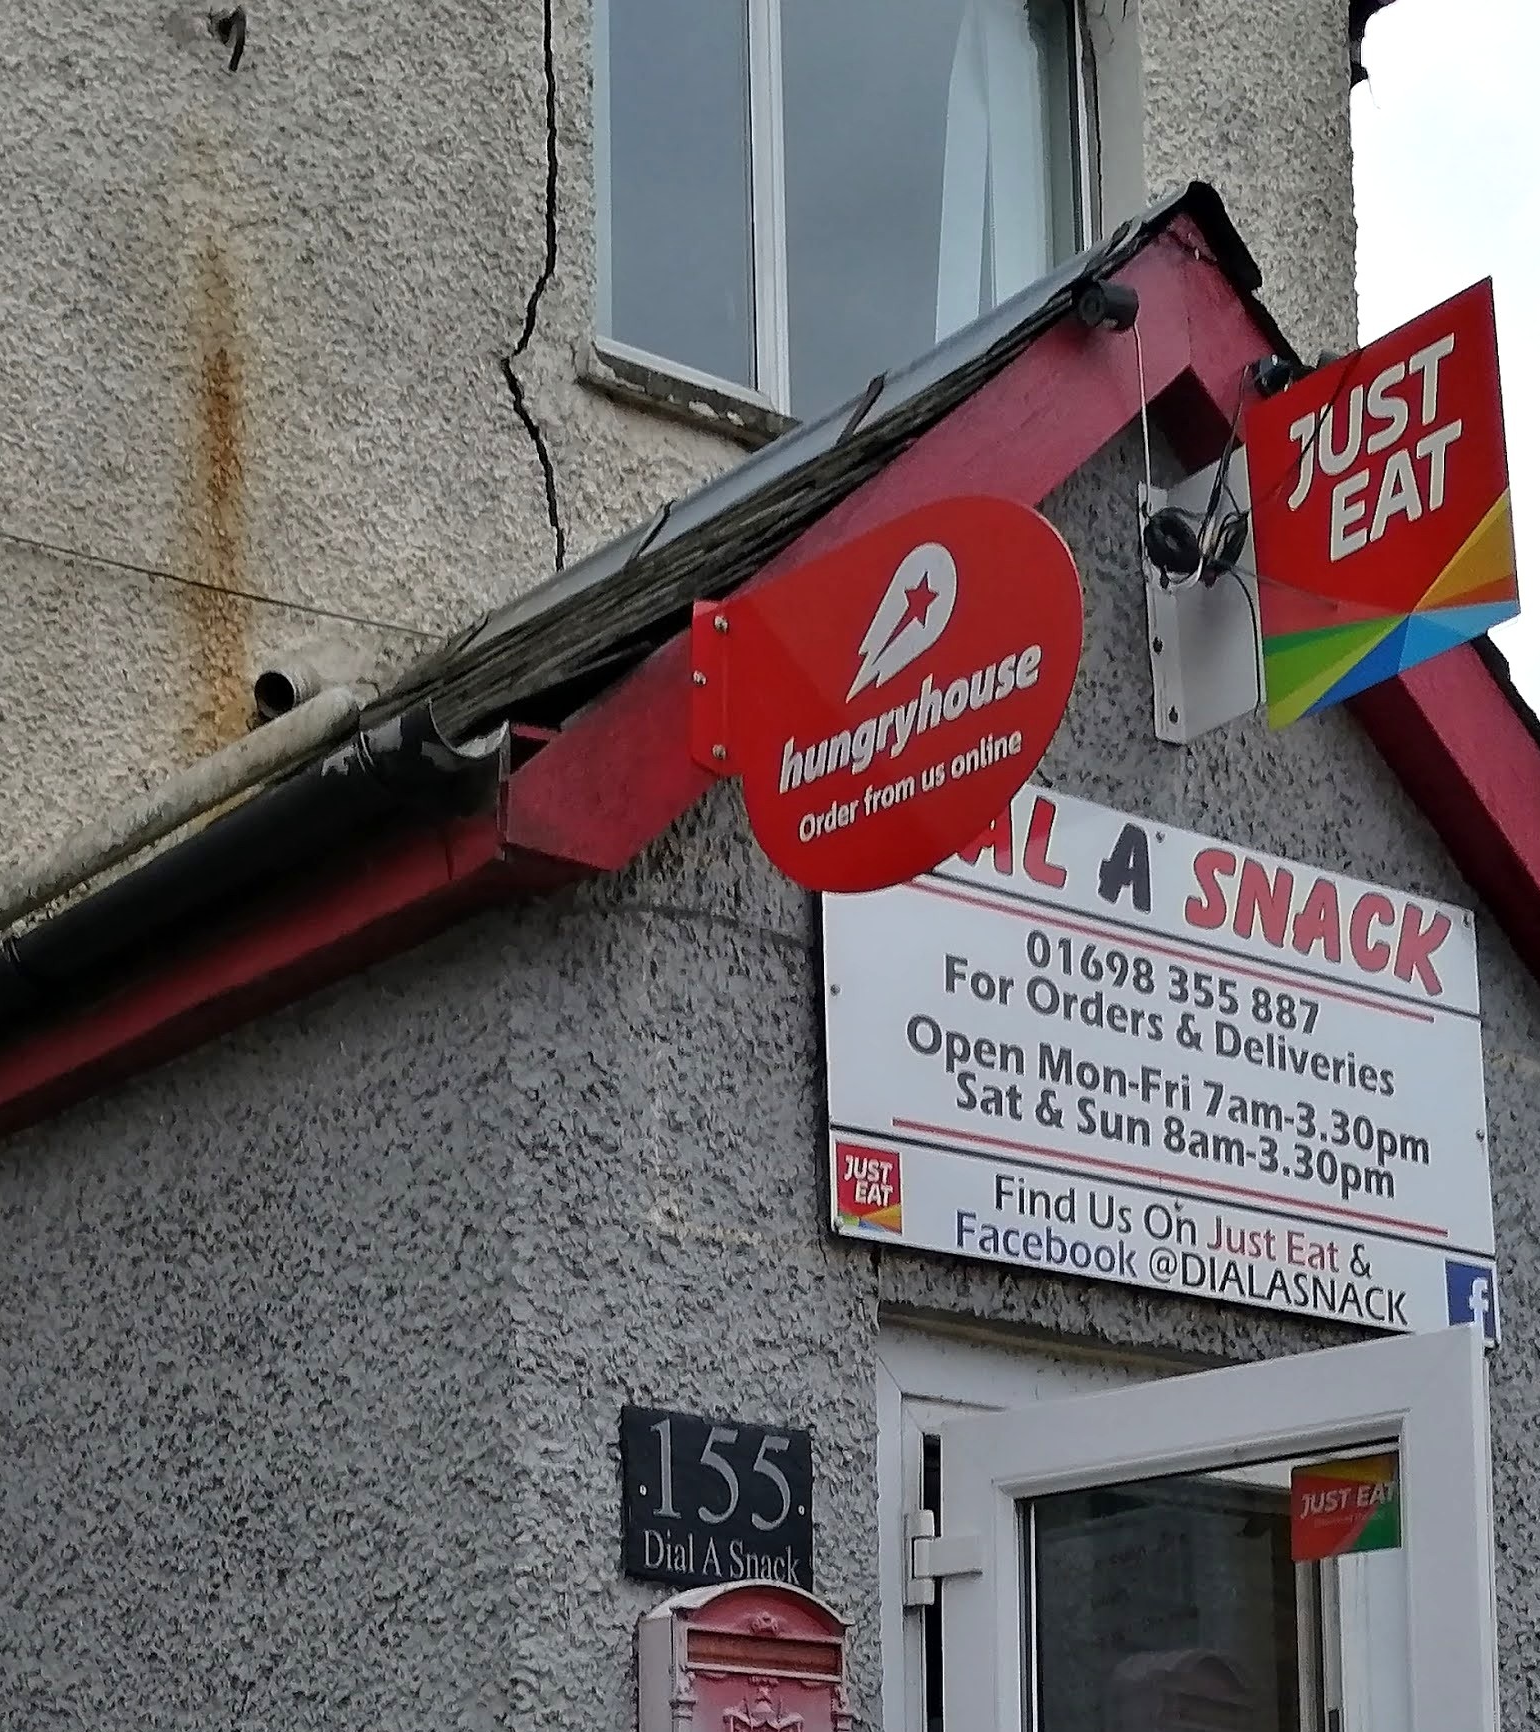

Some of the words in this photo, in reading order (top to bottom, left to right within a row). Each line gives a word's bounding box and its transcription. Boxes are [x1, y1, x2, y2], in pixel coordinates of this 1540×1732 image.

[1288, 333, 1454, 511] JUST
[1330, 419, 1462, 562] EAT
[779, 644, 1042, 794] hungryhouse
[799, 798, 859, 842] Order
[864, 774, 915, 815] from
[921, 760, 946, 789] us
[951, 730, 1022, 778] online
[959, 796, 1067, 888] AL
[1098, 823, 1152, 914] A
[1185, 848, 1451, 996] SNACK
[944, 954, 1015, 1004] For
[1026, 975, 1163, 1041] Orders
[1176, 1014, 1202, 1052] &
[1215, 1023, 1395, 1097] Deliveries
[1027, 930, 1155, 994] 01698
[1168, 966, 1239, 1015] 355
[1252, 988, 1319, 1034] 887
[906, 1014, 1025, 1074] Open
[1038, 1042, 1191, 1109] Mon-Fri
[1203, 1081, 1430, 1165] 7am-3.30pm
[956, 1071, 1023, 1121] Sat
[1034, 1092, 1064, 1130] &
[1077, 1099, 1150, 1146] Sun
[1163, 1116, 1395, 1199] 8am-3.30pm
[844, 1154, 893, 1185] JUST
[855, 1180, 893, 1207] EAT
[955, 1210, 1137, 1279] Facebook
[1147, 1245, 1407, 1325] @DIALASNACK
[995, 1174, 1075, 1224] Find
[1088, 1191, 1131, 1234] Us
[1143, 1204, 1197, 1245] On
[1207, 1215, 1275, 1259] Just
[1286, 1228, 1339, 1272] Eat
[1349, 1243, 1372, 1280] &
[649, 1418, 791, 1531] 155
[1301, 1487, 1351, 1520] JUST
[1357, 1481, 1395, 1507] EAT
[643, 1529, 695, 1575] Dial
[702, 1536, 722, 1578] A
[729, 1539, 801, 1586] Snack
